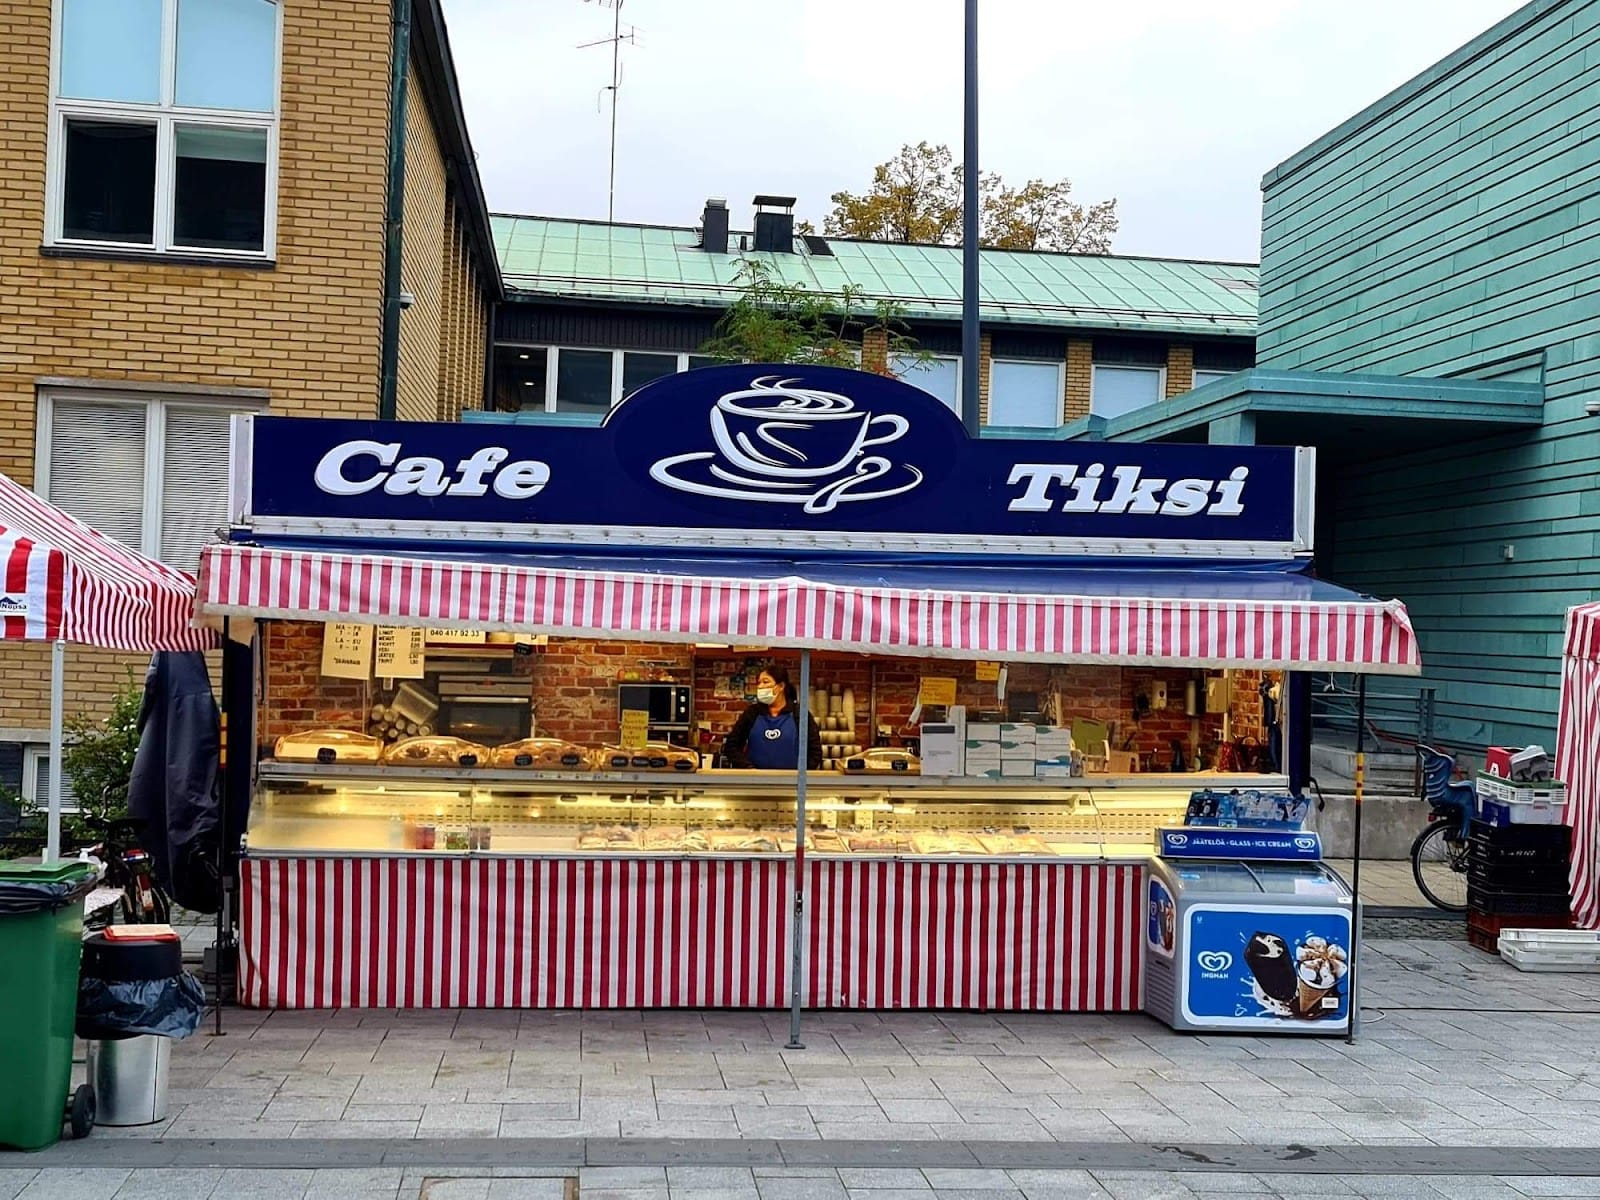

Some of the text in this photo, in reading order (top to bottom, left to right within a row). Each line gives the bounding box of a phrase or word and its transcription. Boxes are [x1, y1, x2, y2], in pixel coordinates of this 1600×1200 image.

[314, 440, 1249, 516] Cafe Tiksi
[1229, 839, 1251, 847] GLASS
